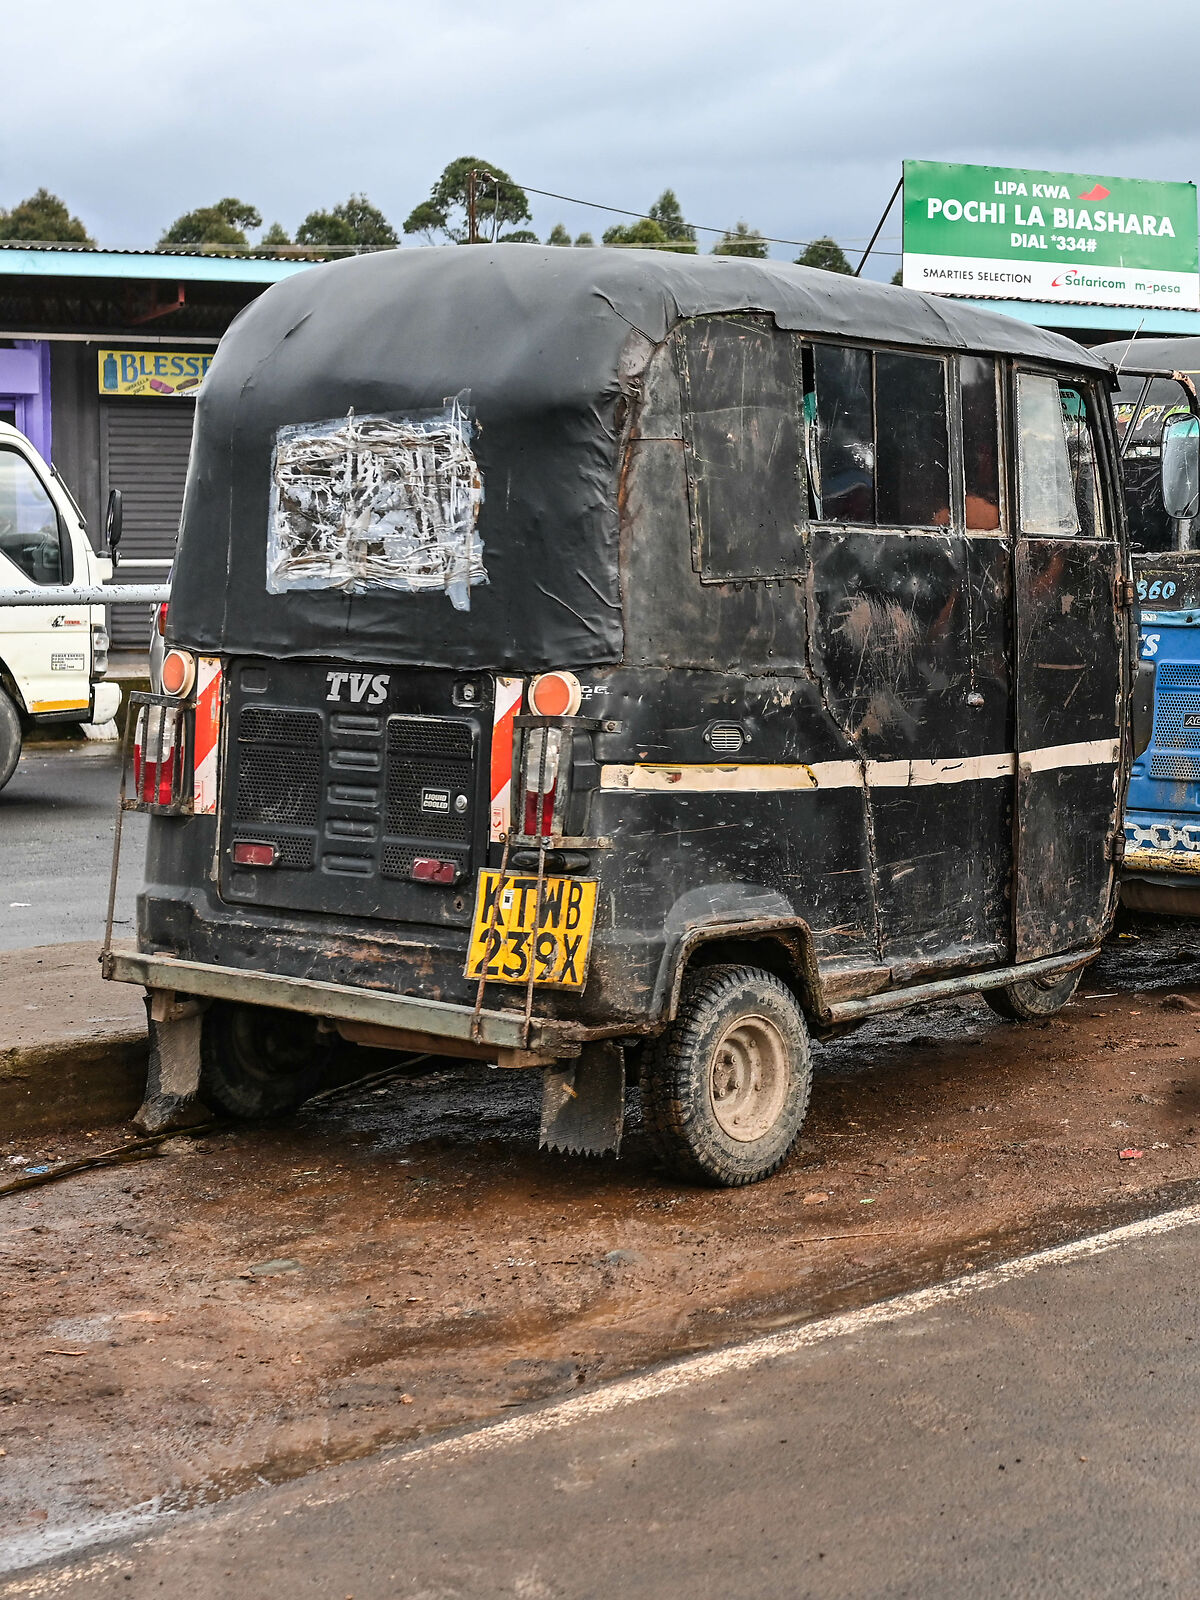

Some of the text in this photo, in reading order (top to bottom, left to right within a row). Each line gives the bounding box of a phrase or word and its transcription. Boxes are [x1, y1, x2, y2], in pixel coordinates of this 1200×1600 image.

[994, 181, 1070, 199] LIPA KWA
[927, 198, 1175, 238] POCHI LA BIASHARA
[1010, 232, 1048, 249] DIAL
[923, 268, 1032, 284] SMARTIES SELECTION
[1065, 275, 1126, 290] Safaricom
[326, 671, 391, 704] TVS
[423, 800, 448, 809] COOLED
[424, 793, 448, 801] LIQUID
[481, 876, 583, 930] KTWB
[475, 928, 583, 983] 239X
